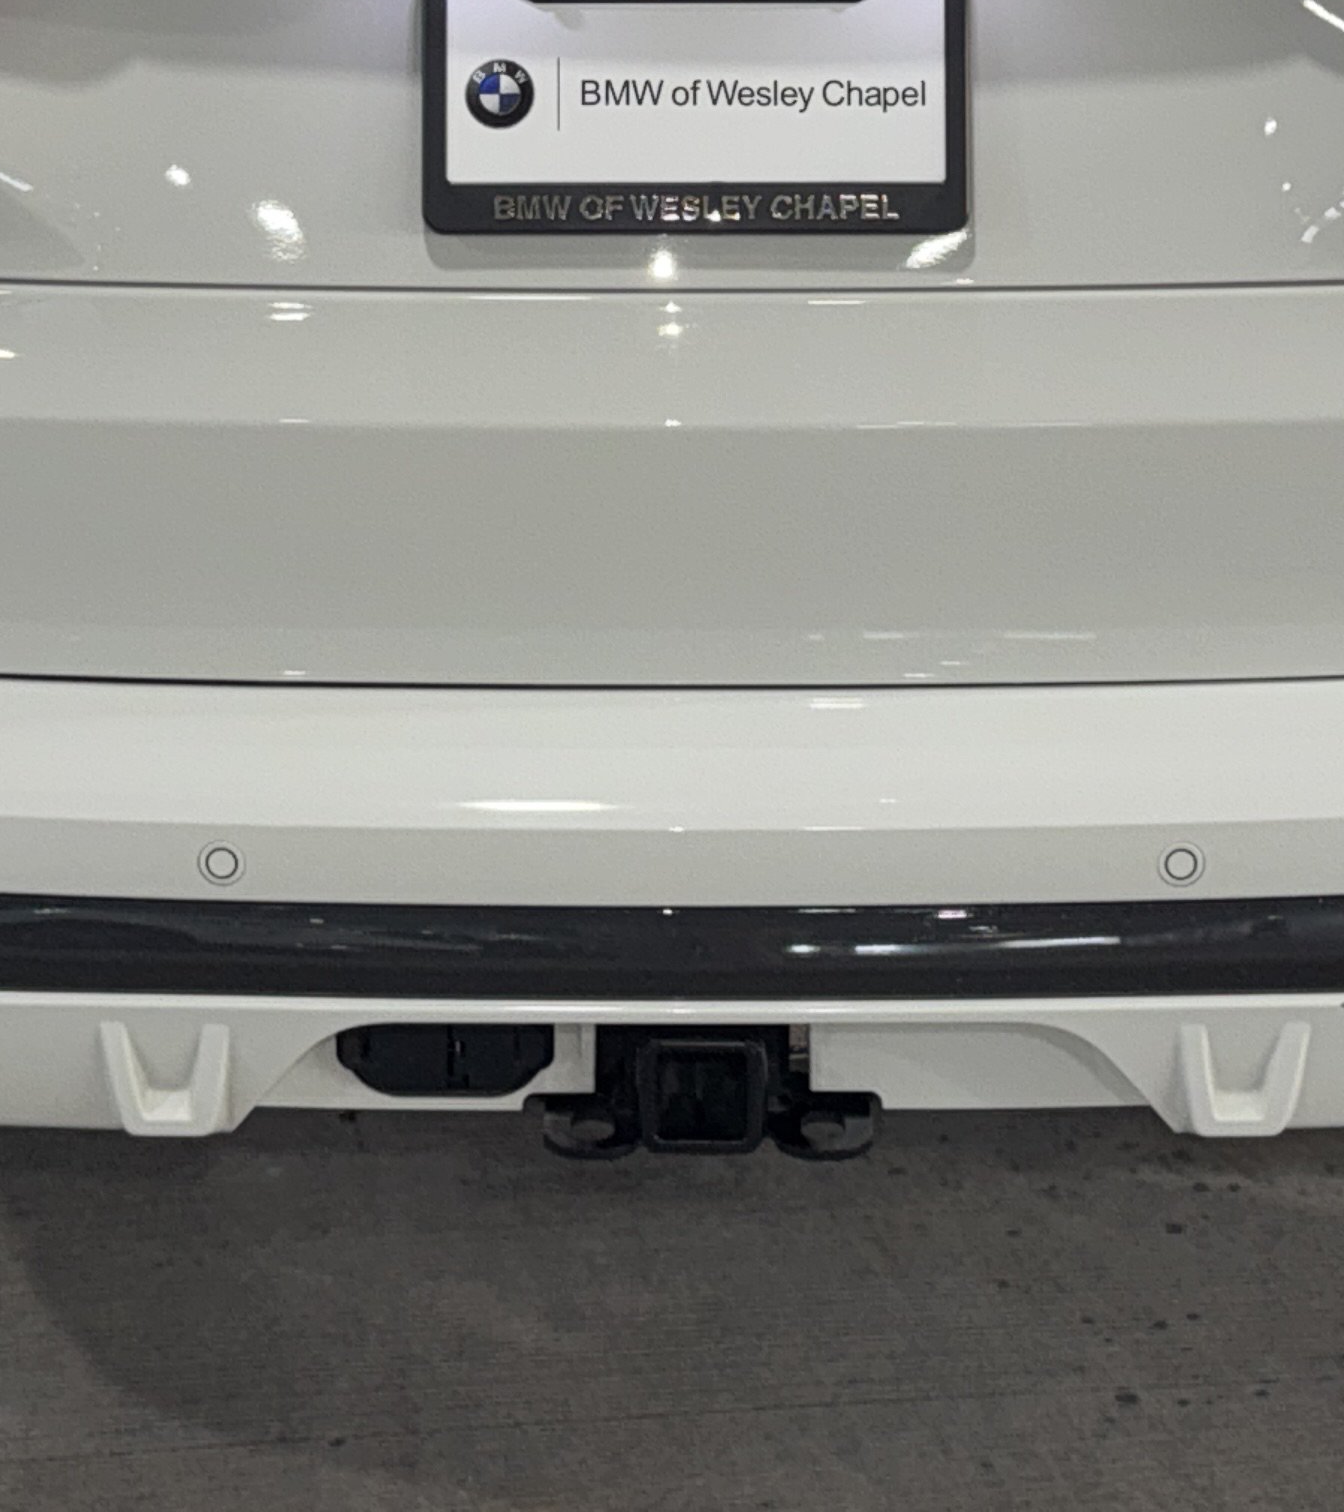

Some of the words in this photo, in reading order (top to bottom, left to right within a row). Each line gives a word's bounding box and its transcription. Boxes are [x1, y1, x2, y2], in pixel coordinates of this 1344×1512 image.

[581, 81, 662, 106] BMW
[671, 79, 702, 106] of
[707, 80, 814, 113] Wesley
[822, 80, 926, 113] Chapel
[494, 195, 571, 220] BMW
[579, 195, 624, 220] OF
[630, 195, 759, 222] WESLEY
[770, 195, 900, 220] CHAPEL
